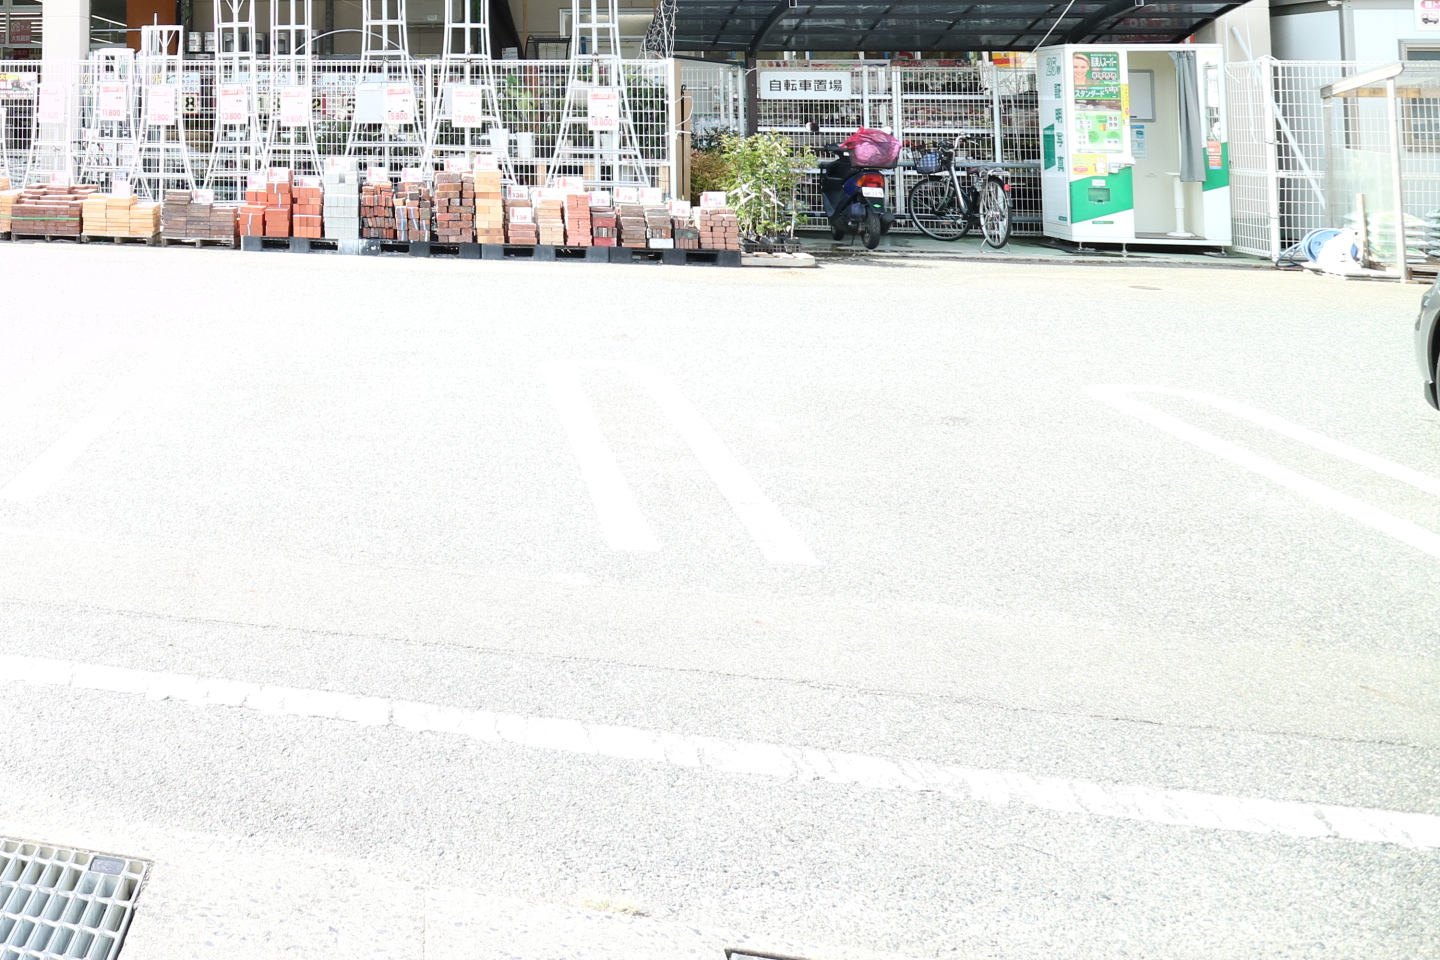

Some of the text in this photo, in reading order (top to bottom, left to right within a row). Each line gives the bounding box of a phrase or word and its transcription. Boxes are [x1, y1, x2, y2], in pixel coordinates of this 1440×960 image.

[769, 79, 843, 92] 自転車置場
